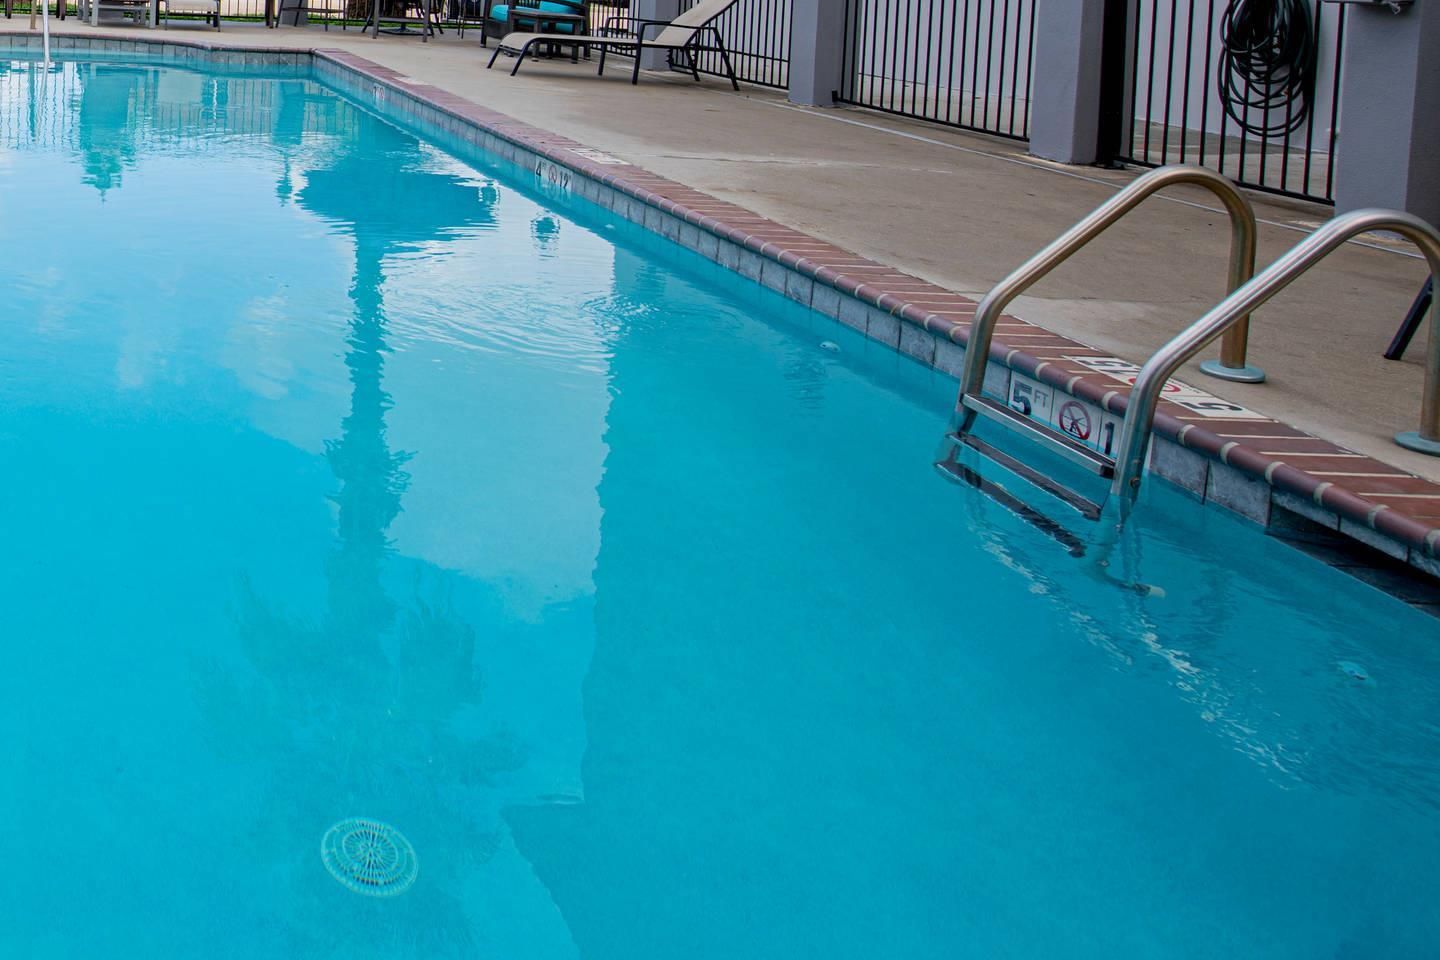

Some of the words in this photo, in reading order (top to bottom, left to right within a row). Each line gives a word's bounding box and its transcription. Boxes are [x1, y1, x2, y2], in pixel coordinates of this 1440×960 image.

[536, 161, 542, 176] 4
[1013, 380, 1032, 415] 5
[1034, 389, 1048, 408] FT
[1178, 401, 1243, 411] 5
